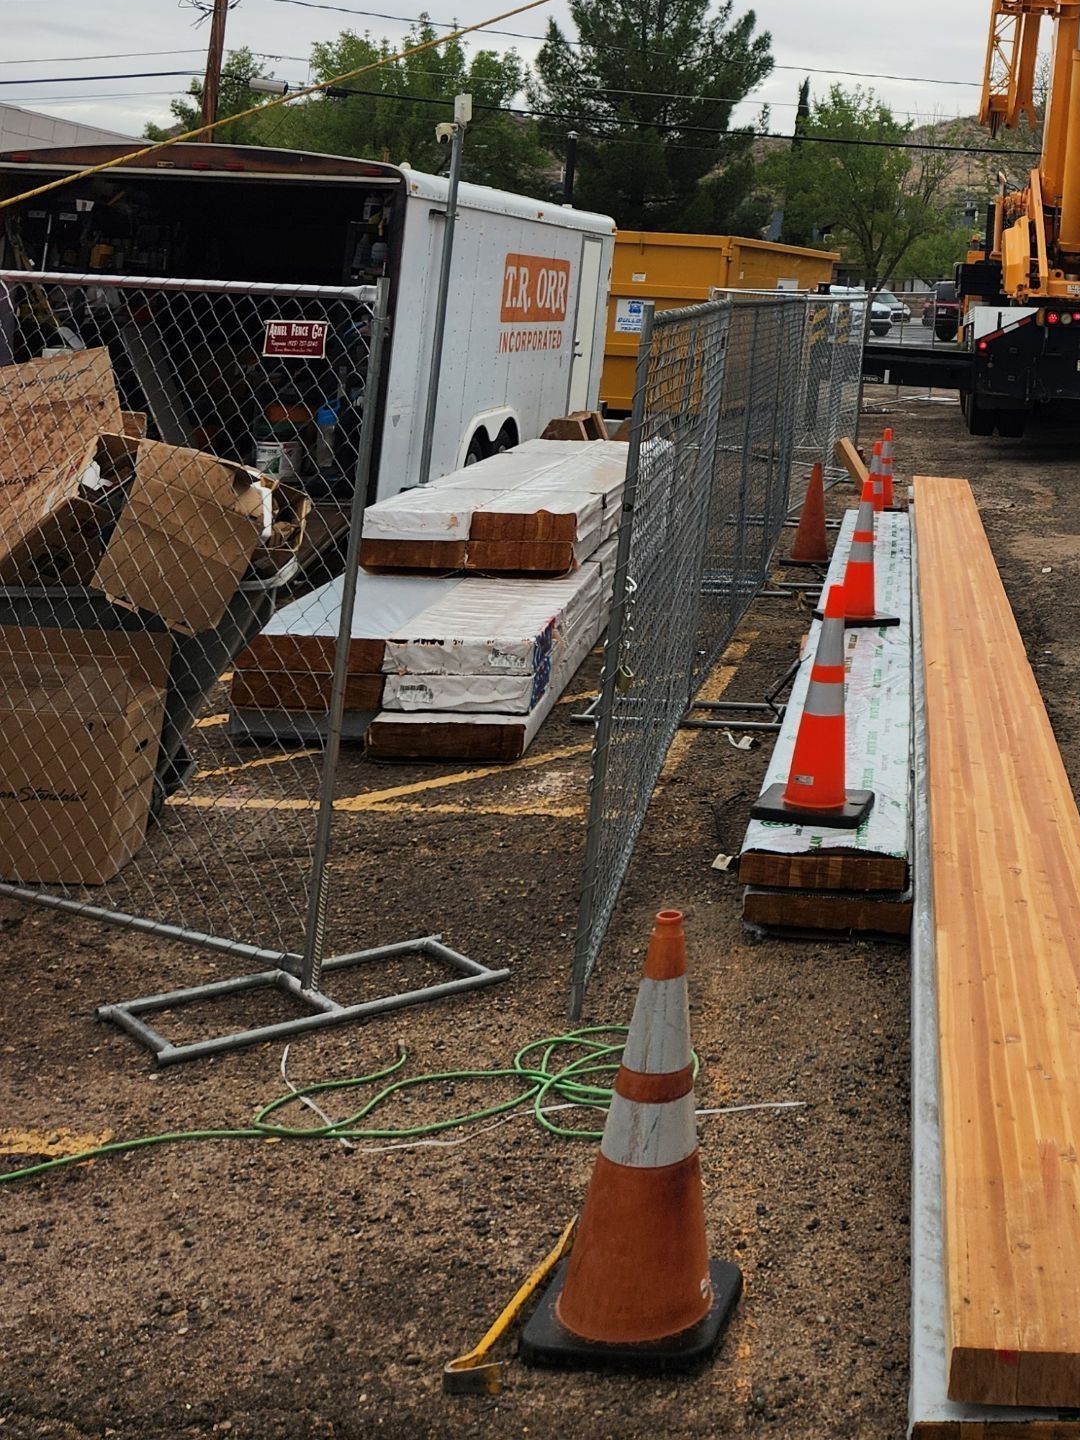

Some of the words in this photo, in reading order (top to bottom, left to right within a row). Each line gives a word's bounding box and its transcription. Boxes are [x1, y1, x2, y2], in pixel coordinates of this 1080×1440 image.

[505, 266, 531, 313] T.R.
[536, 267, 567, 314] ORR
[498, 330, 562, 353] INCORPORATED
